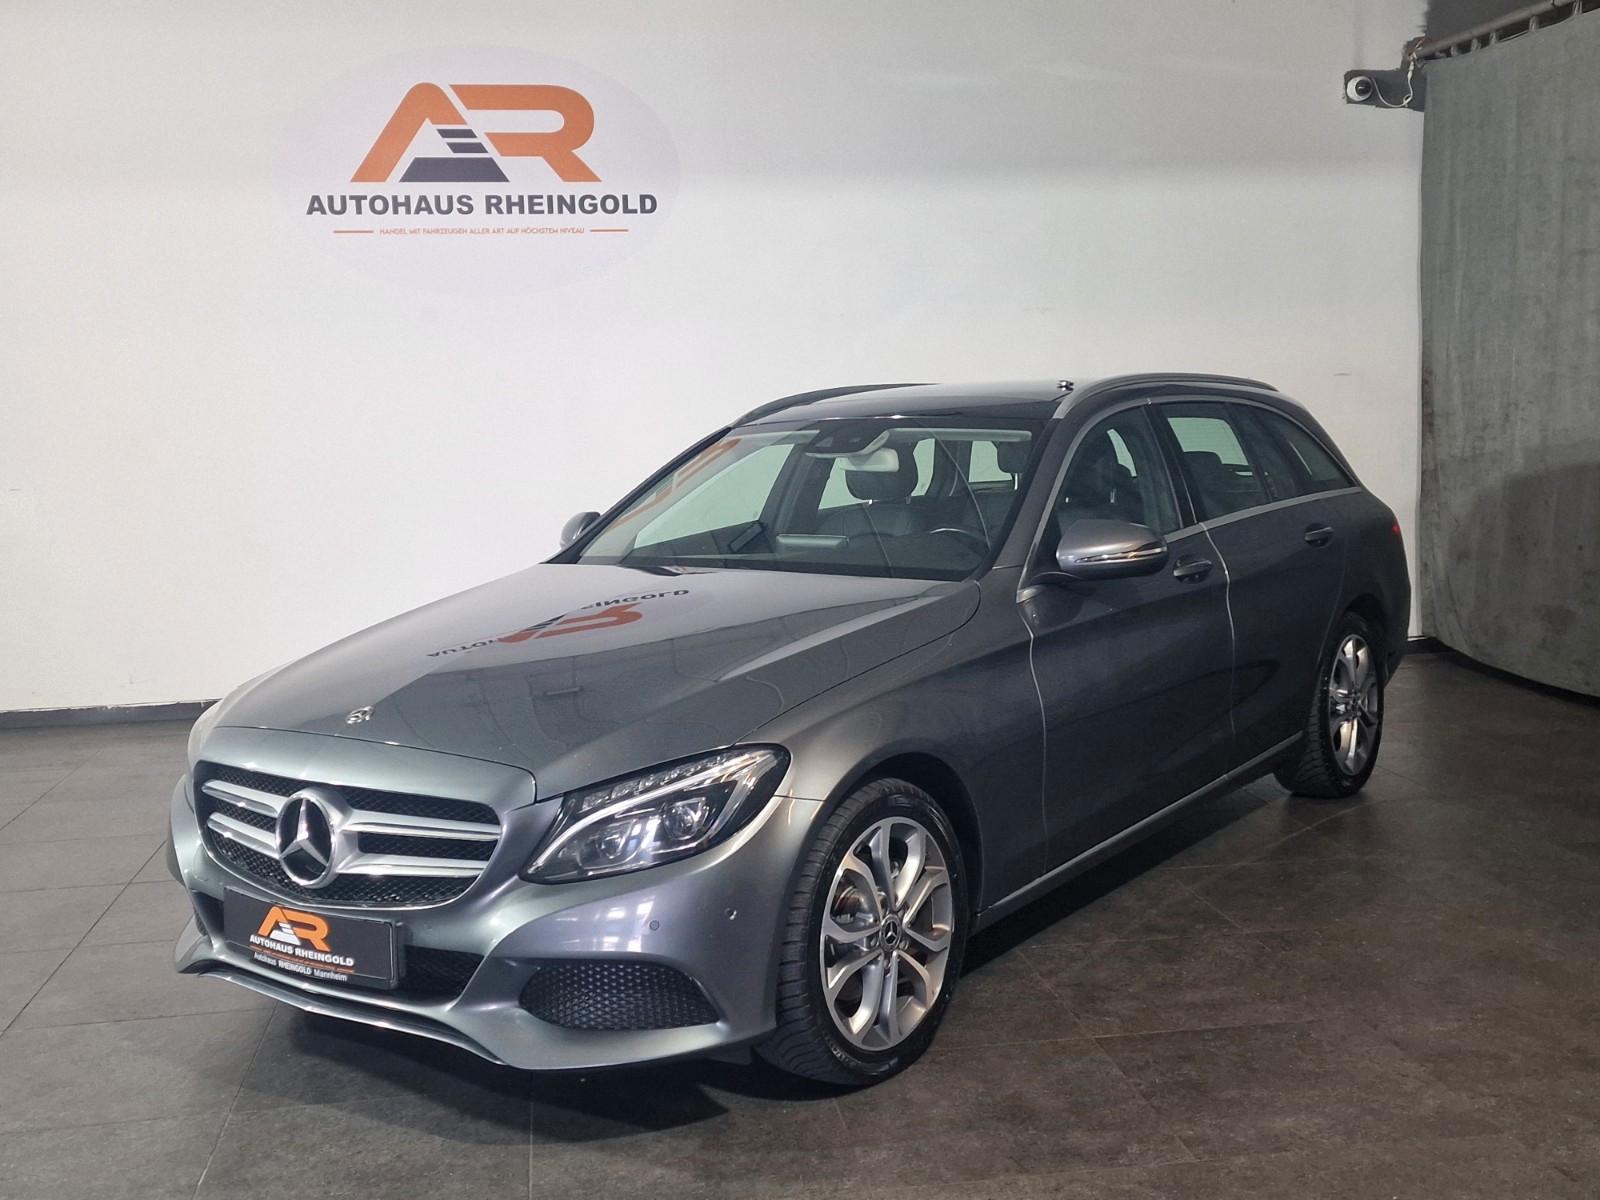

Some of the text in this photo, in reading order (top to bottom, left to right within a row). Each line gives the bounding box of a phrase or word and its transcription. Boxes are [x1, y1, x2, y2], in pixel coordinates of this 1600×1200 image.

[306, 193, 658, 216] AUTOHAUS RHEINGOLD
[250, 934, 293, 955] AUTOHAUS
[295, 947, 354, 967] RHEINGOLD
[278, 959, 312, 975] RHEINGOLD
[314, 968, 348, 982] Mannheim
